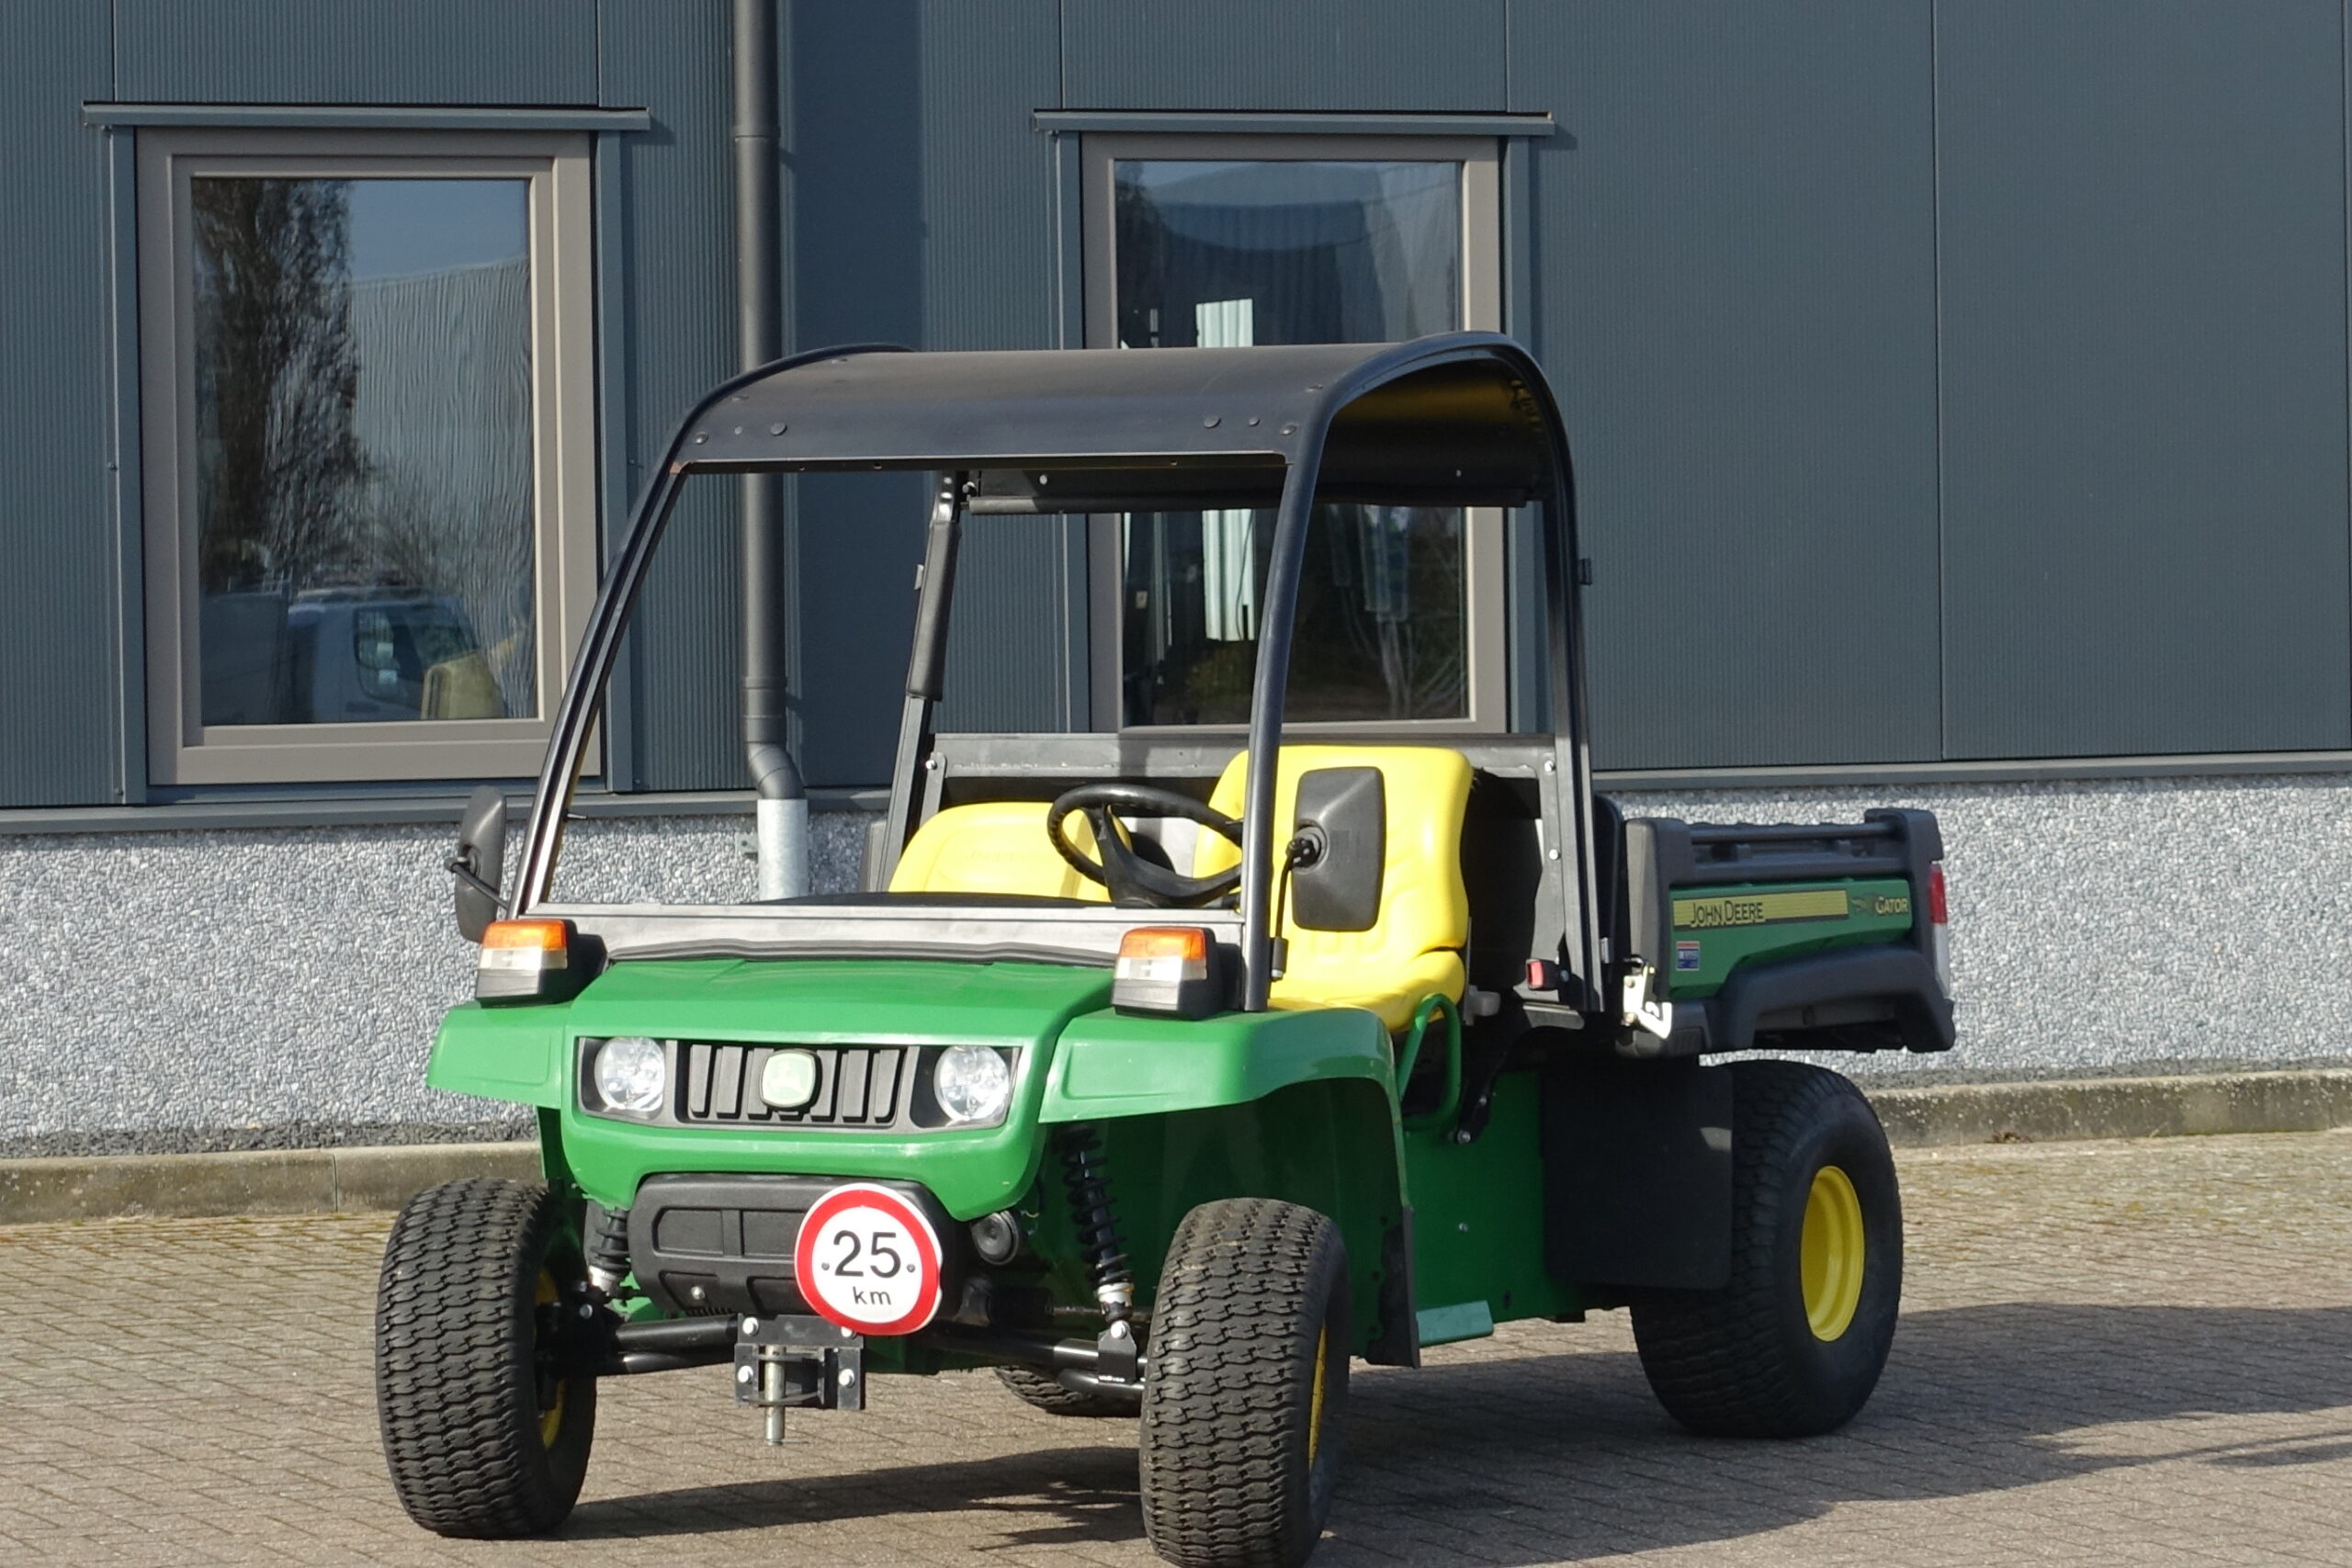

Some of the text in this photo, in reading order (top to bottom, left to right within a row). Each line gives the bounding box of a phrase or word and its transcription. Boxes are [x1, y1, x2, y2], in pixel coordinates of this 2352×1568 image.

[1690, 900, 1764, 924] JOHN DEERE
[1875, 896, 1909, 915] GATOR
[833, 1230, 901, 1279] 25
[853, 1286, 892, 1305] km
